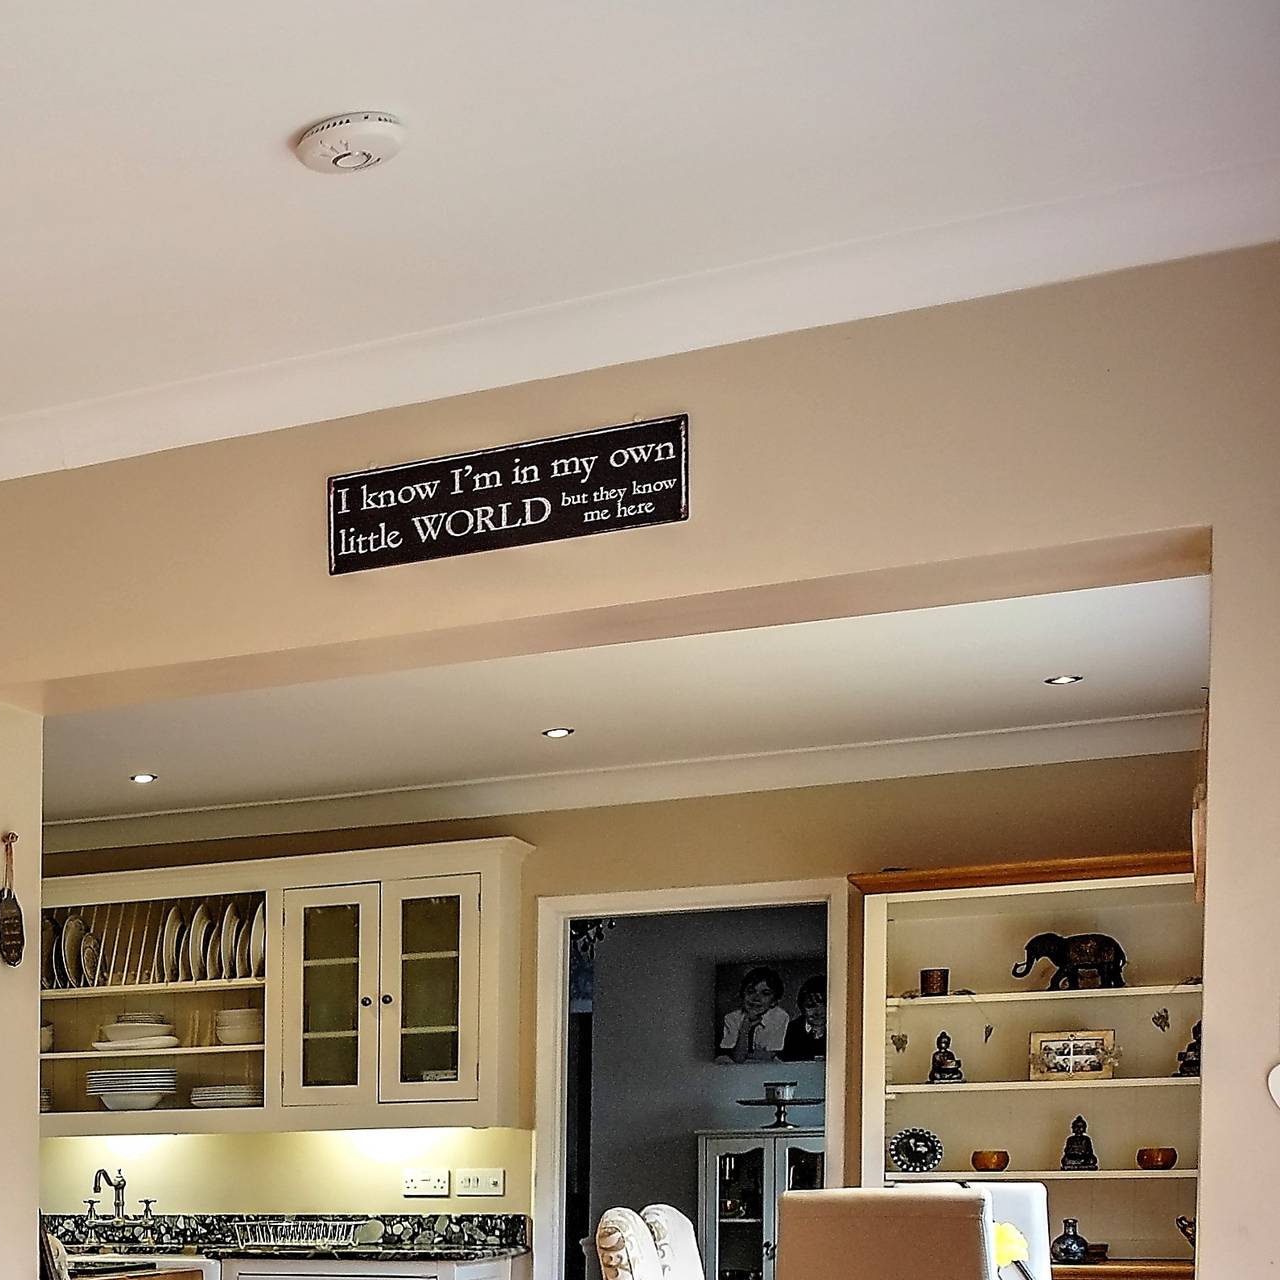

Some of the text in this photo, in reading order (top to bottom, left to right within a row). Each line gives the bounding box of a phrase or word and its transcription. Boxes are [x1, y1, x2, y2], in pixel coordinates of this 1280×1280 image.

[336, 440, 676, 515] I know I'm in my own
[560, 475, 677, 508] but they know
[337, 496, 552, 556] little WORLD
[582, 498, 656, 524] me here
